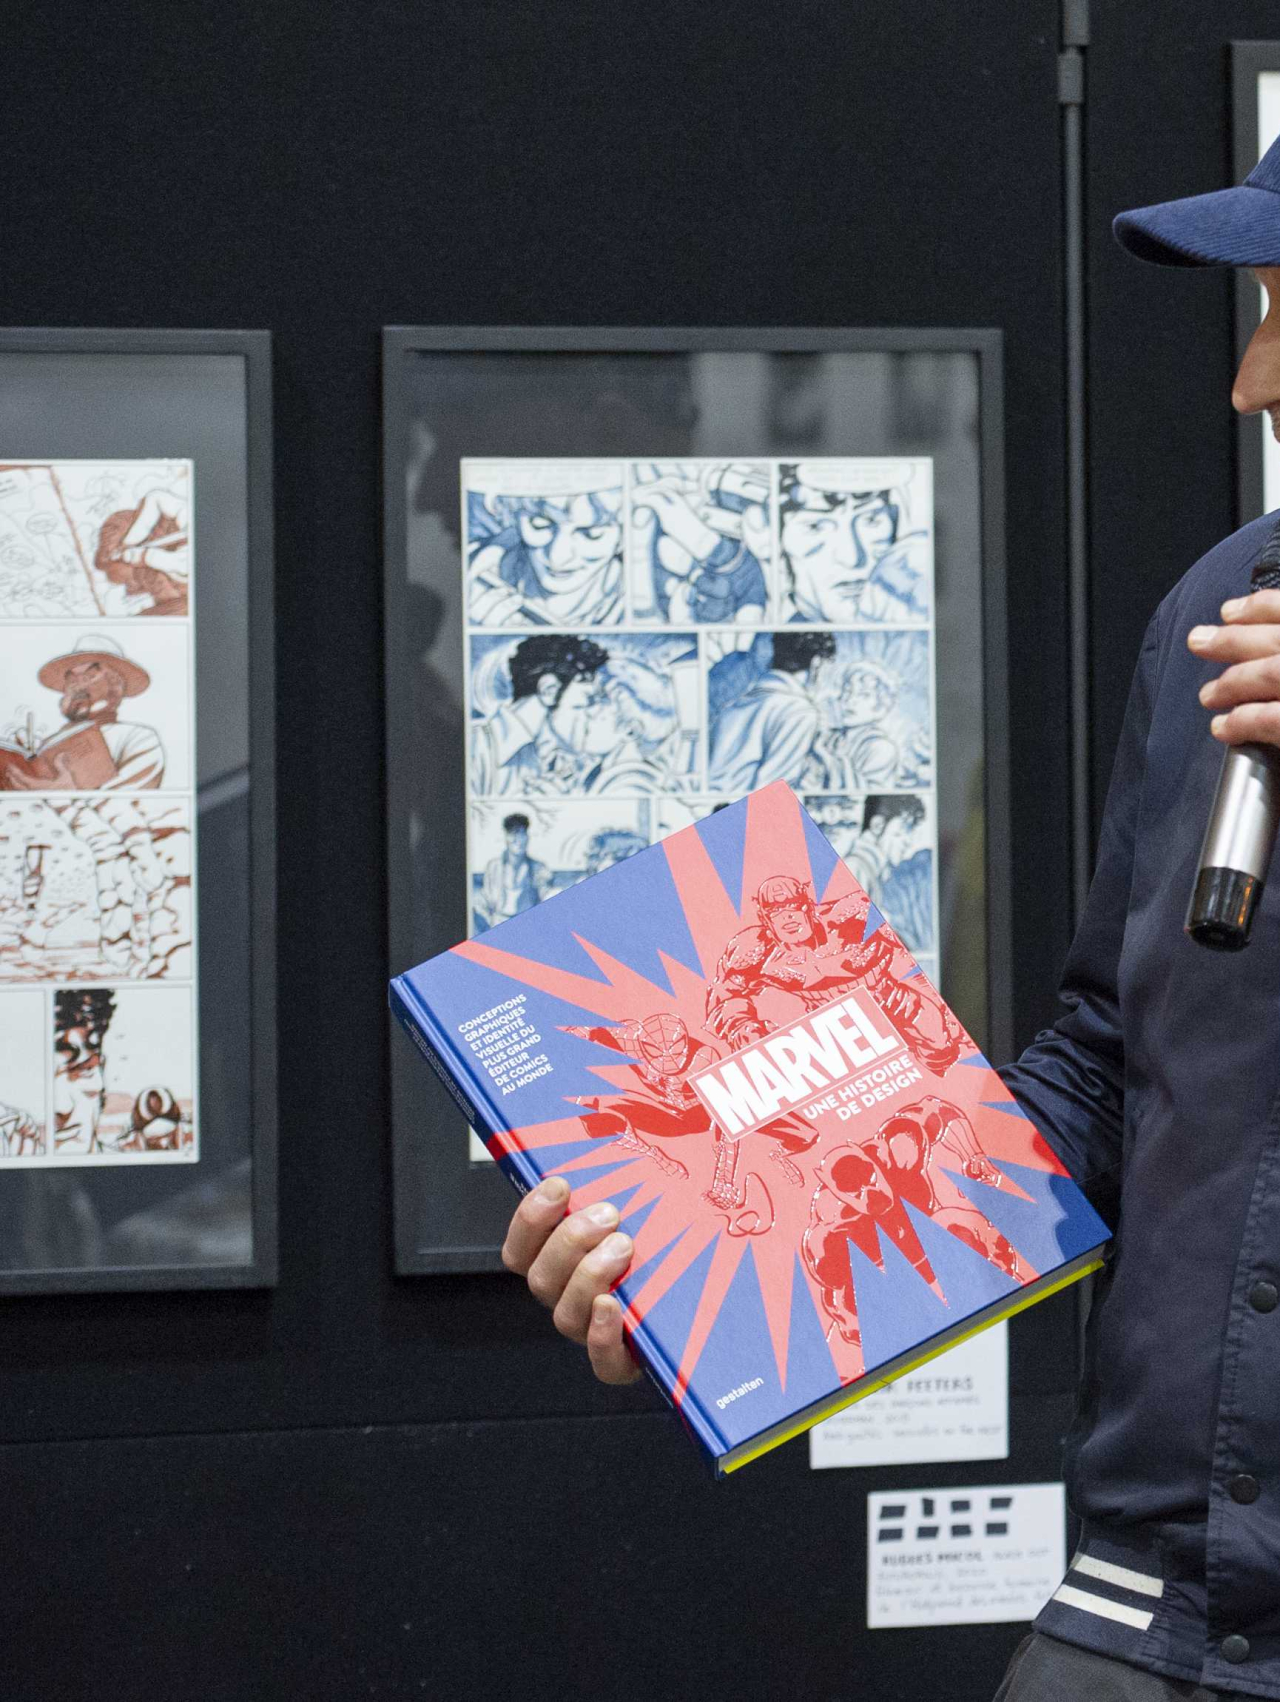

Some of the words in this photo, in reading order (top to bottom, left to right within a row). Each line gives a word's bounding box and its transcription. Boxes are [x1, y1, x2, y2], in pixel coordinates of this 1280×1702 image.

[458, 993, 527, 1033] CONCEPTIONS
[464, 1006, 526, 1042] GRAPHIQUES
[469, 1040, 483, 1051] ET
[482, 1017, 526, 1045] IDENTITÉ
[475, 1032, 520, 1059] VISUELLE
[519, 1024, 536, 1038] DU
[481, 1051, 507, 1069] PLUS
[506, 1034, 542, 1056] GRAND
[488, 1051, 530, 1077] ÉDITEUR
[494, 1074, 510, 1087] DE
[509, 1054, 549, 1078] COMICS
[501, 1082, 516, 1096] AU
[516, 1063, 554, 1088] MONDE
[695, 997, 900, 1135] MARVEL
[803, 1094, 839, 1121] UNE
[838, 1054, 914, 1101] HISTOIRE
[836, 1101, 862, 1121] DE
[860, 1068, 923, 1107] DESIGN
[716, 1376, 765, 1410] gestalten
